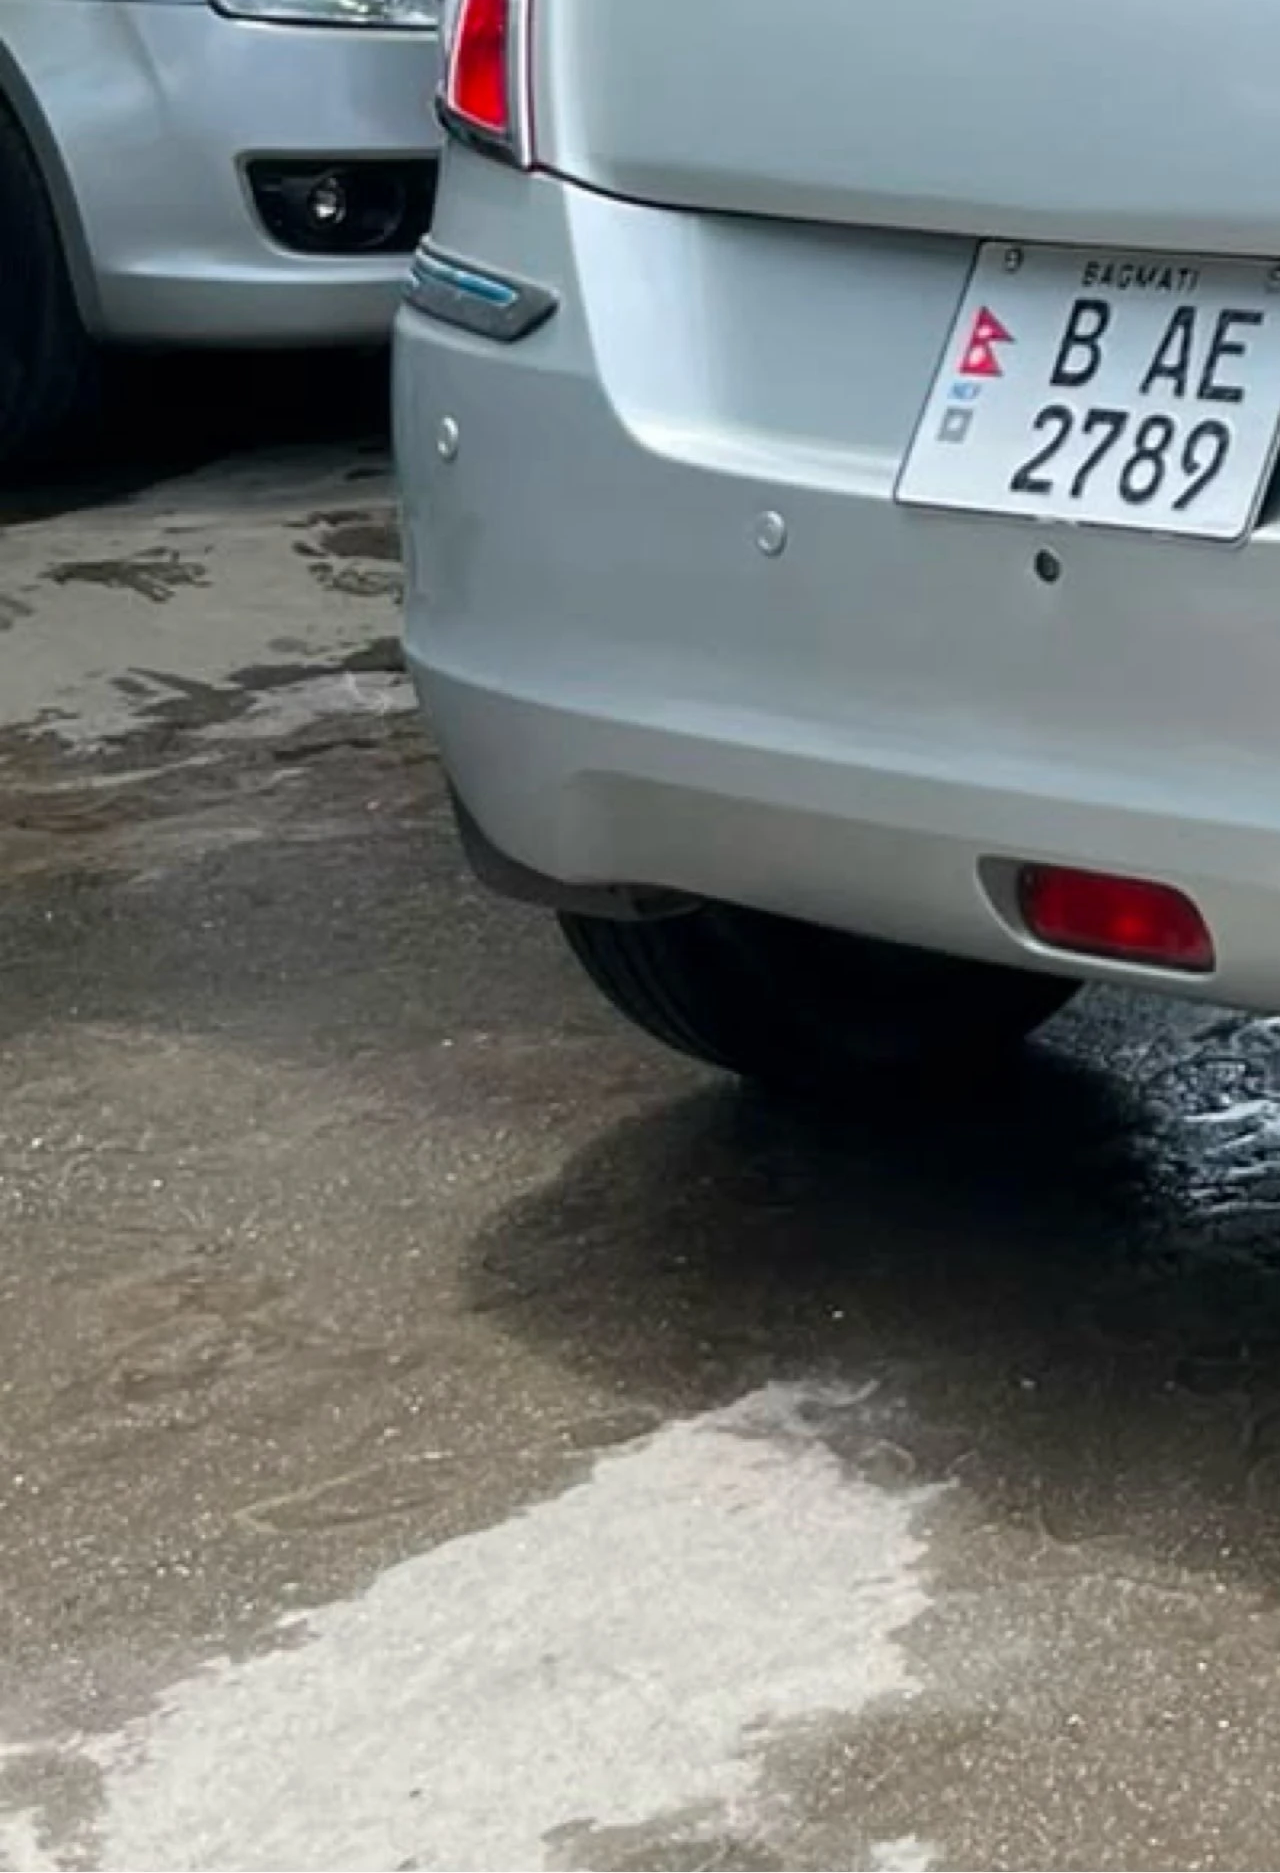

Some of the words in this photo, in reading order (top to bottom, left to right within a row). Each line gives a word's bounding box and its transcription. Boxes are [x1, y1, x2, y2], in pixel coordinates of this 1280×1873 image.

[1080, 260, 1199, 293] BAGMATI
[1049, 298, 1111, 387] B
[1138, 305, 1265, 404] AE
[1009, 404, 1231, 512] 2789
